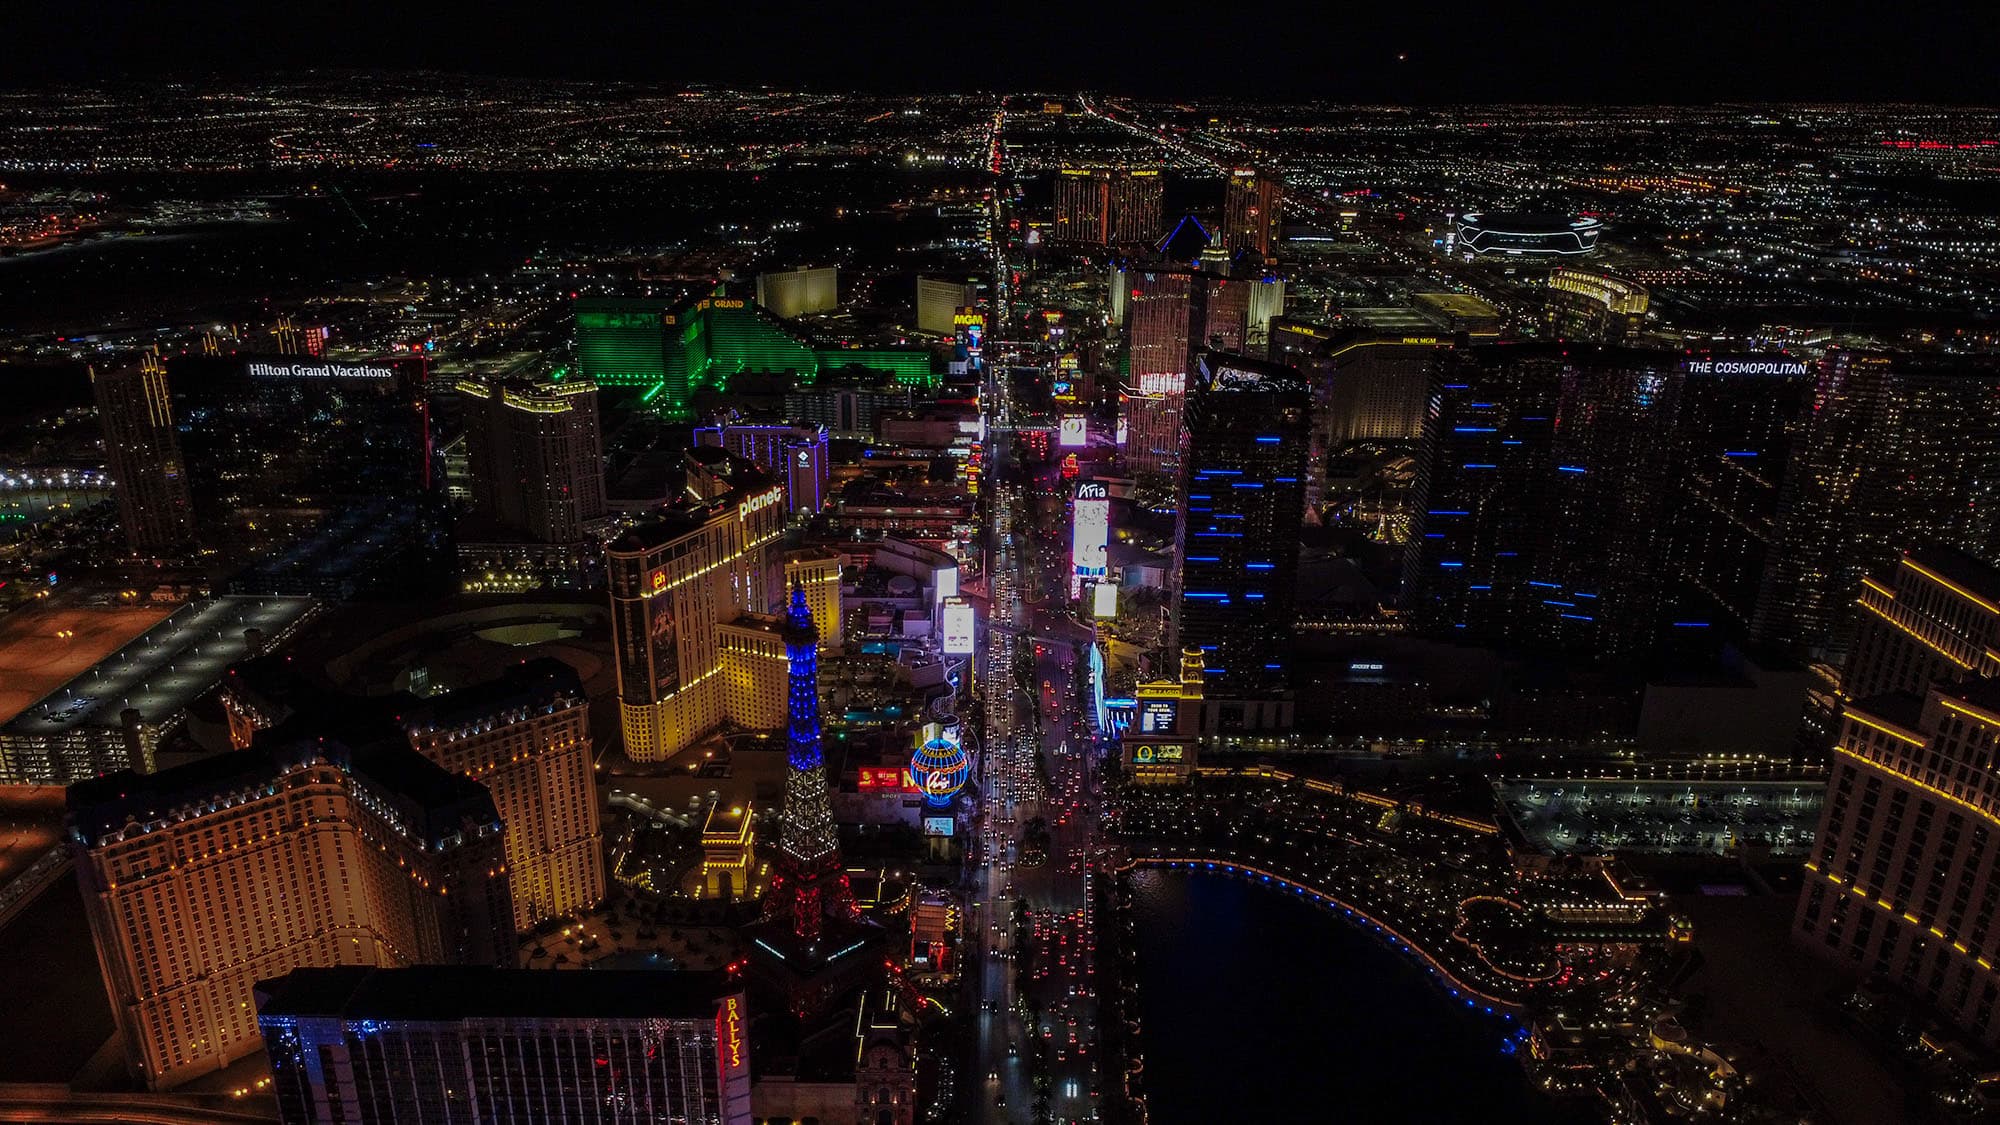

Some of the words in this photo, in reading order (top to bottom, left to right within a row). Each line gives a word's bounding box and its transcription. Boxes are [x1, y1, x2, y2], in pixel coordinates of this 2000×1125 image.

[714, 299, 744, 309] GRAND
[953, 314, 984, 325] MGM
[249, 363, 290, 376] Hilton
[291, 364, 330, 377] Grand
[330, 364, 392, 377] Vacations
[1688, 361, 1712, 373] THE
[1715, 362, 1807, 375] COSMOPOLITAN
[1078, 483, 1106, 498] Aria
[739, 485, 781, 522] planet
[926, 770, 950, 794] Paris
[727, 998, 741, 1067] BALLYS
